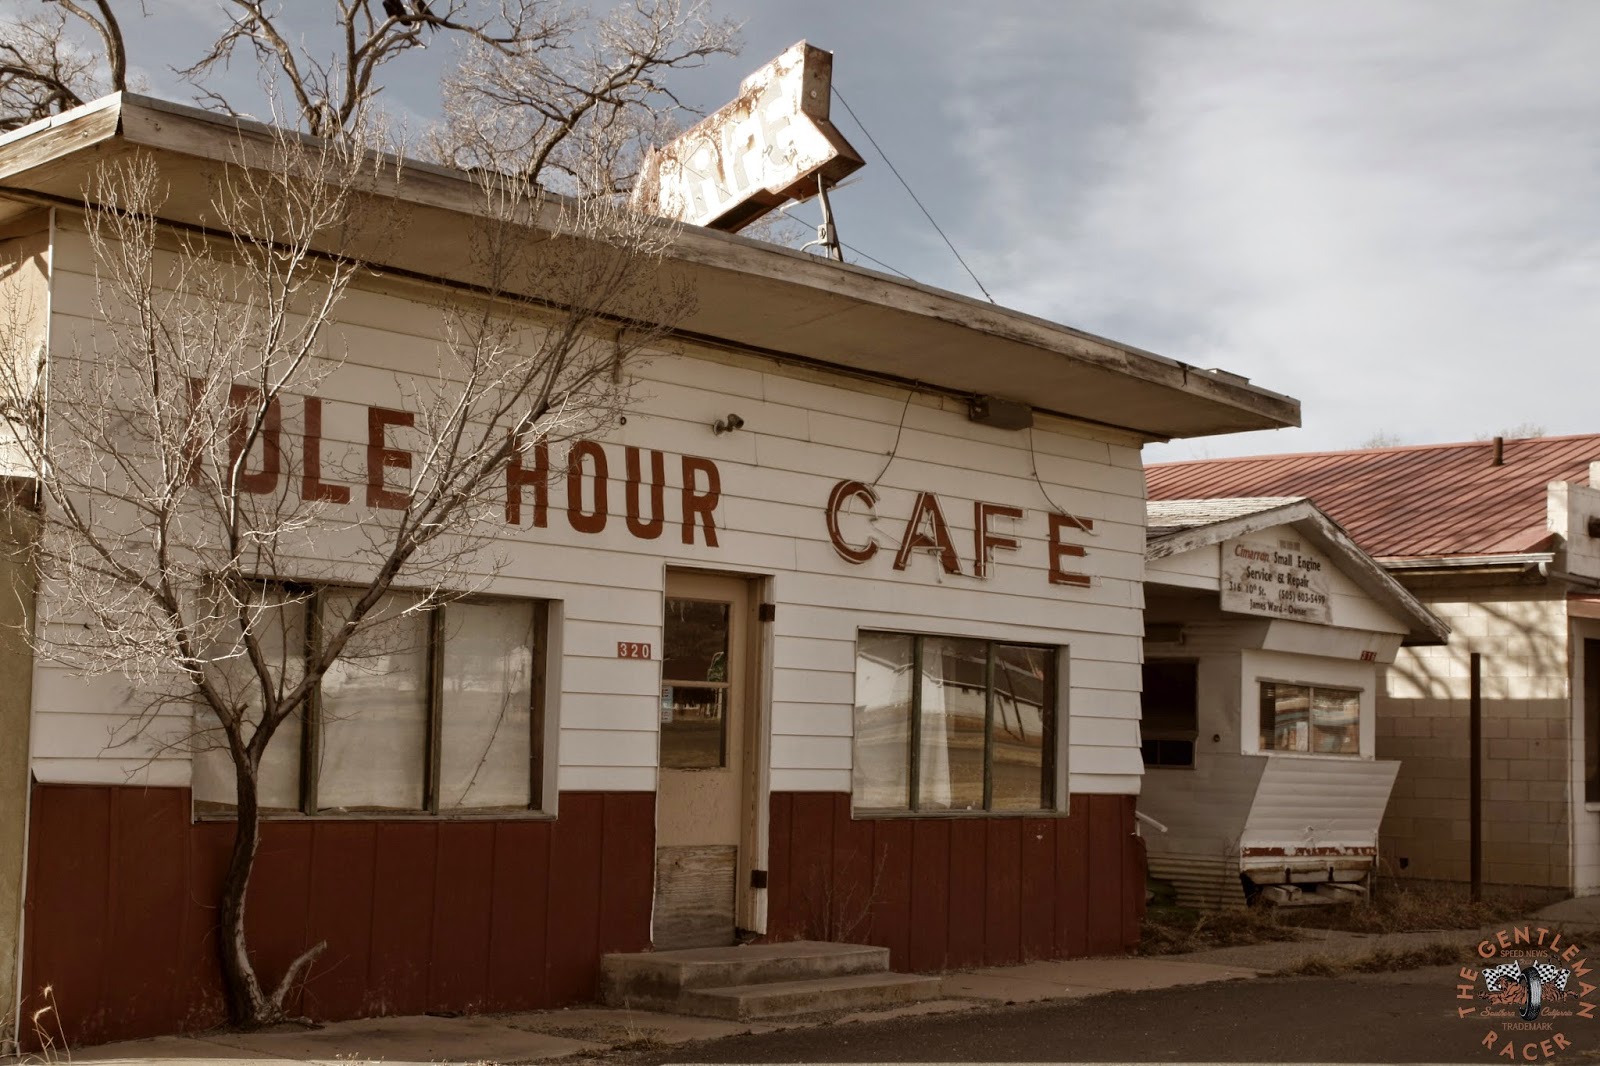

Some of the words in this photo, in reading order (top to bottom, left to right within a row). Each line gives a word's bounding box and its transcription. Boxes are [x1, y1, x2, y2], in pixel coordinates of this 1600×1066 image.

[185, 377, 414, 511] IDLE
[505, 426, 721, 548] HOUR
[825, 478, 1096, 589] CAFE
[1234, 544, 1270, 563] Cimarron
[1273, 551, 1293, 567] Small
[1297, 555, 1321, 572] Engine
[1246, 565, 1273, 582] Service
[1277, 573, 1285, 584] &
[1287, 572, 1310, 589] Repair
[1278, 588, 1297, 603] (505)
[1249, 598, 1267, 611] James
[1267, 601, 1283, 613] Ward
[1288, 604, 1307, 616] Owner
[620, 643, 649, 659] 320
